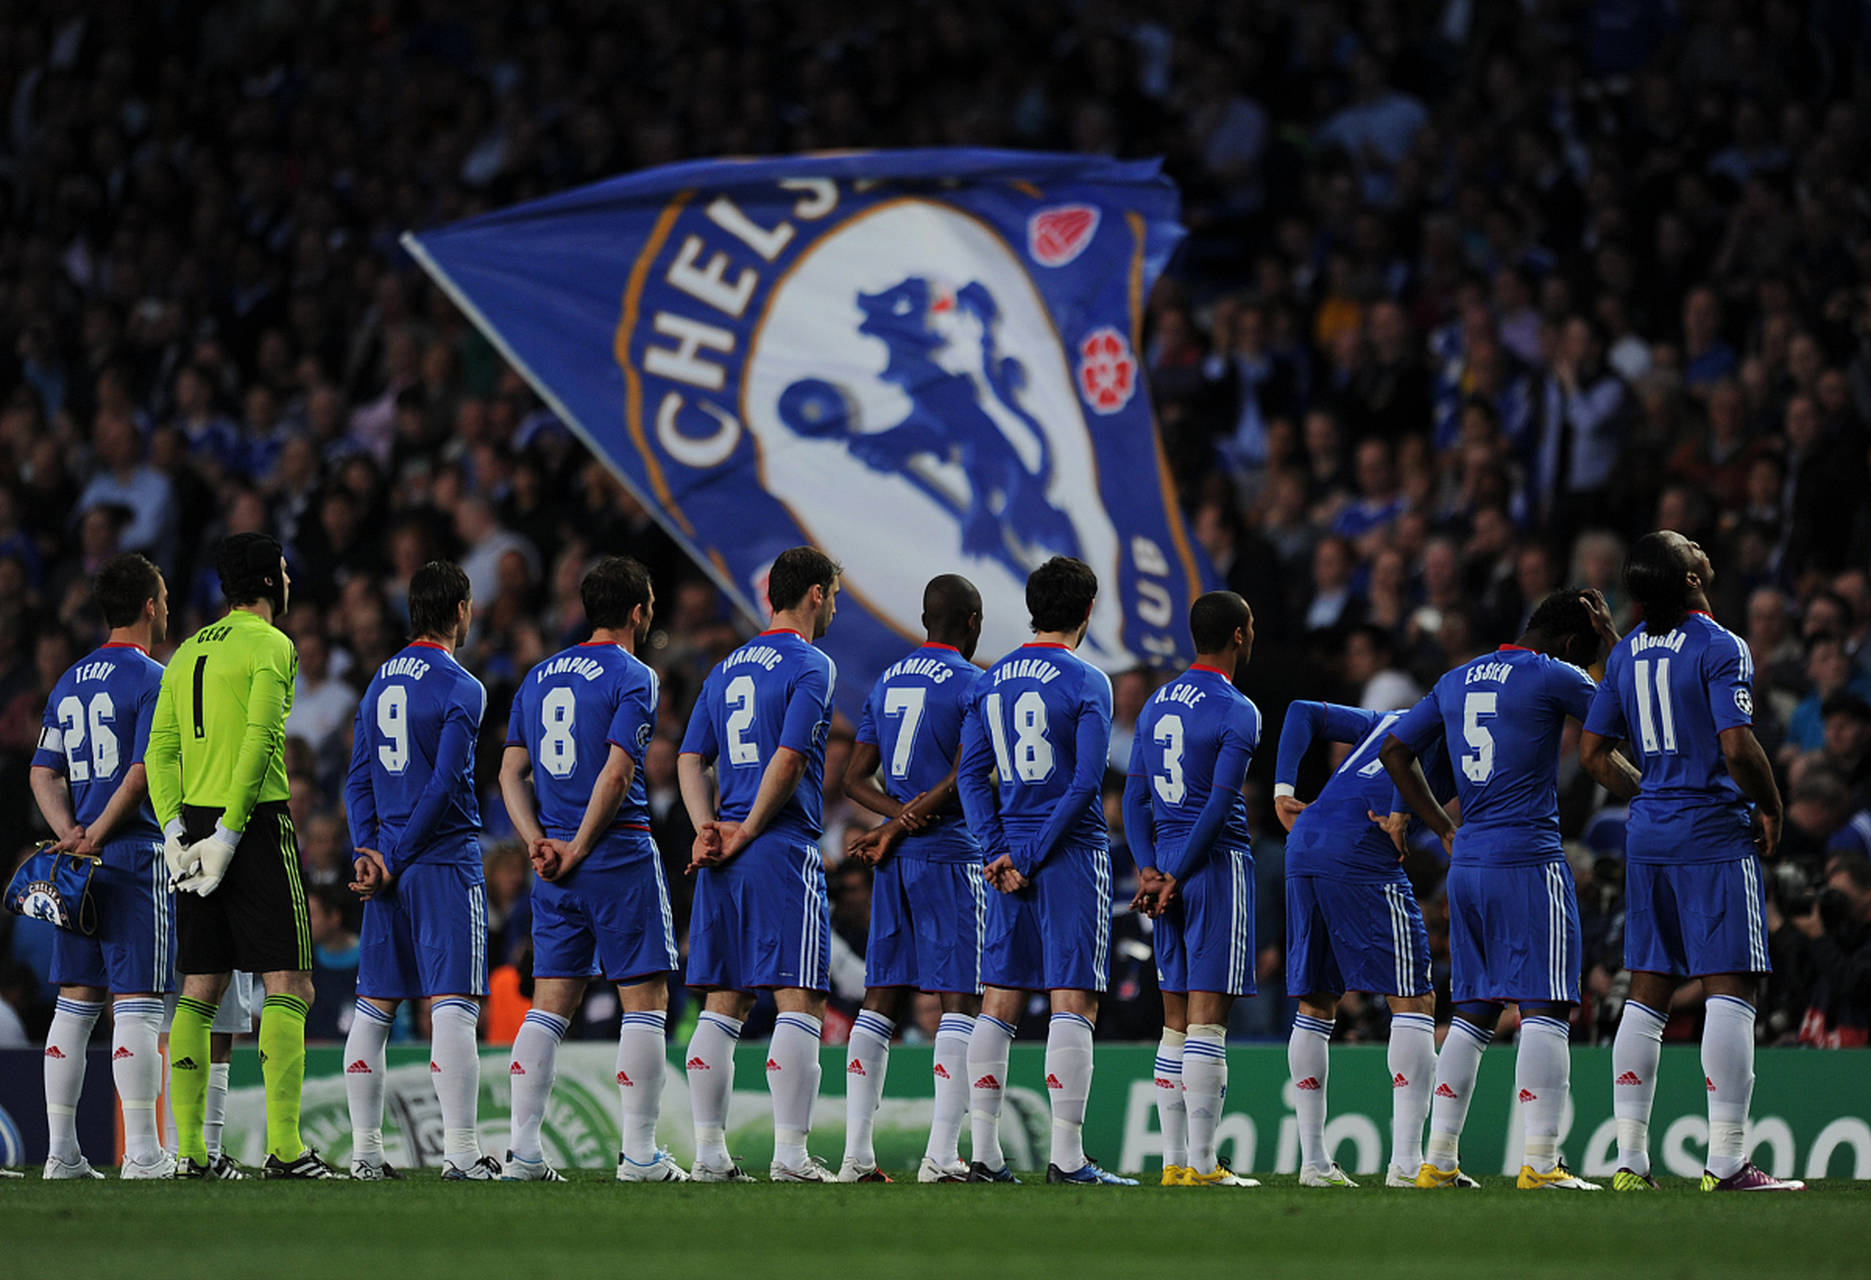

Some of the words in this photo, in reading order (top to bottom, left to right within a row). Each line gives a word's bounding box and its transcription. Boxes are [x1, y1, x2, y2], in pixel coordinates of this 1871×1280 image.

[75, 661, 116, 684] TERRY
[193, 654, 208, 739] 1
[380, 657, 431, 681] TORRES
[537, 656, 604, 684] LAMPARD
[882, 657, 954, 684] RAMIRES
[992, 657, 1062, 687] ZHIRKOV
[1154, 683, 1206, 710] A.COLE
[1634, 659, 1677, 754] 11
[57, 691, 120, 782] 26
[376, 684, 411, 774] 9
[540, 686, 578, 777] 8
[725, 675, 761, 767] 2
[883, 687, 927, 778] 7
[986, 691, 1056, 784] 18
[1153, 713, 1187, 806] 3
[1461, 691, 1499, 785] 5
